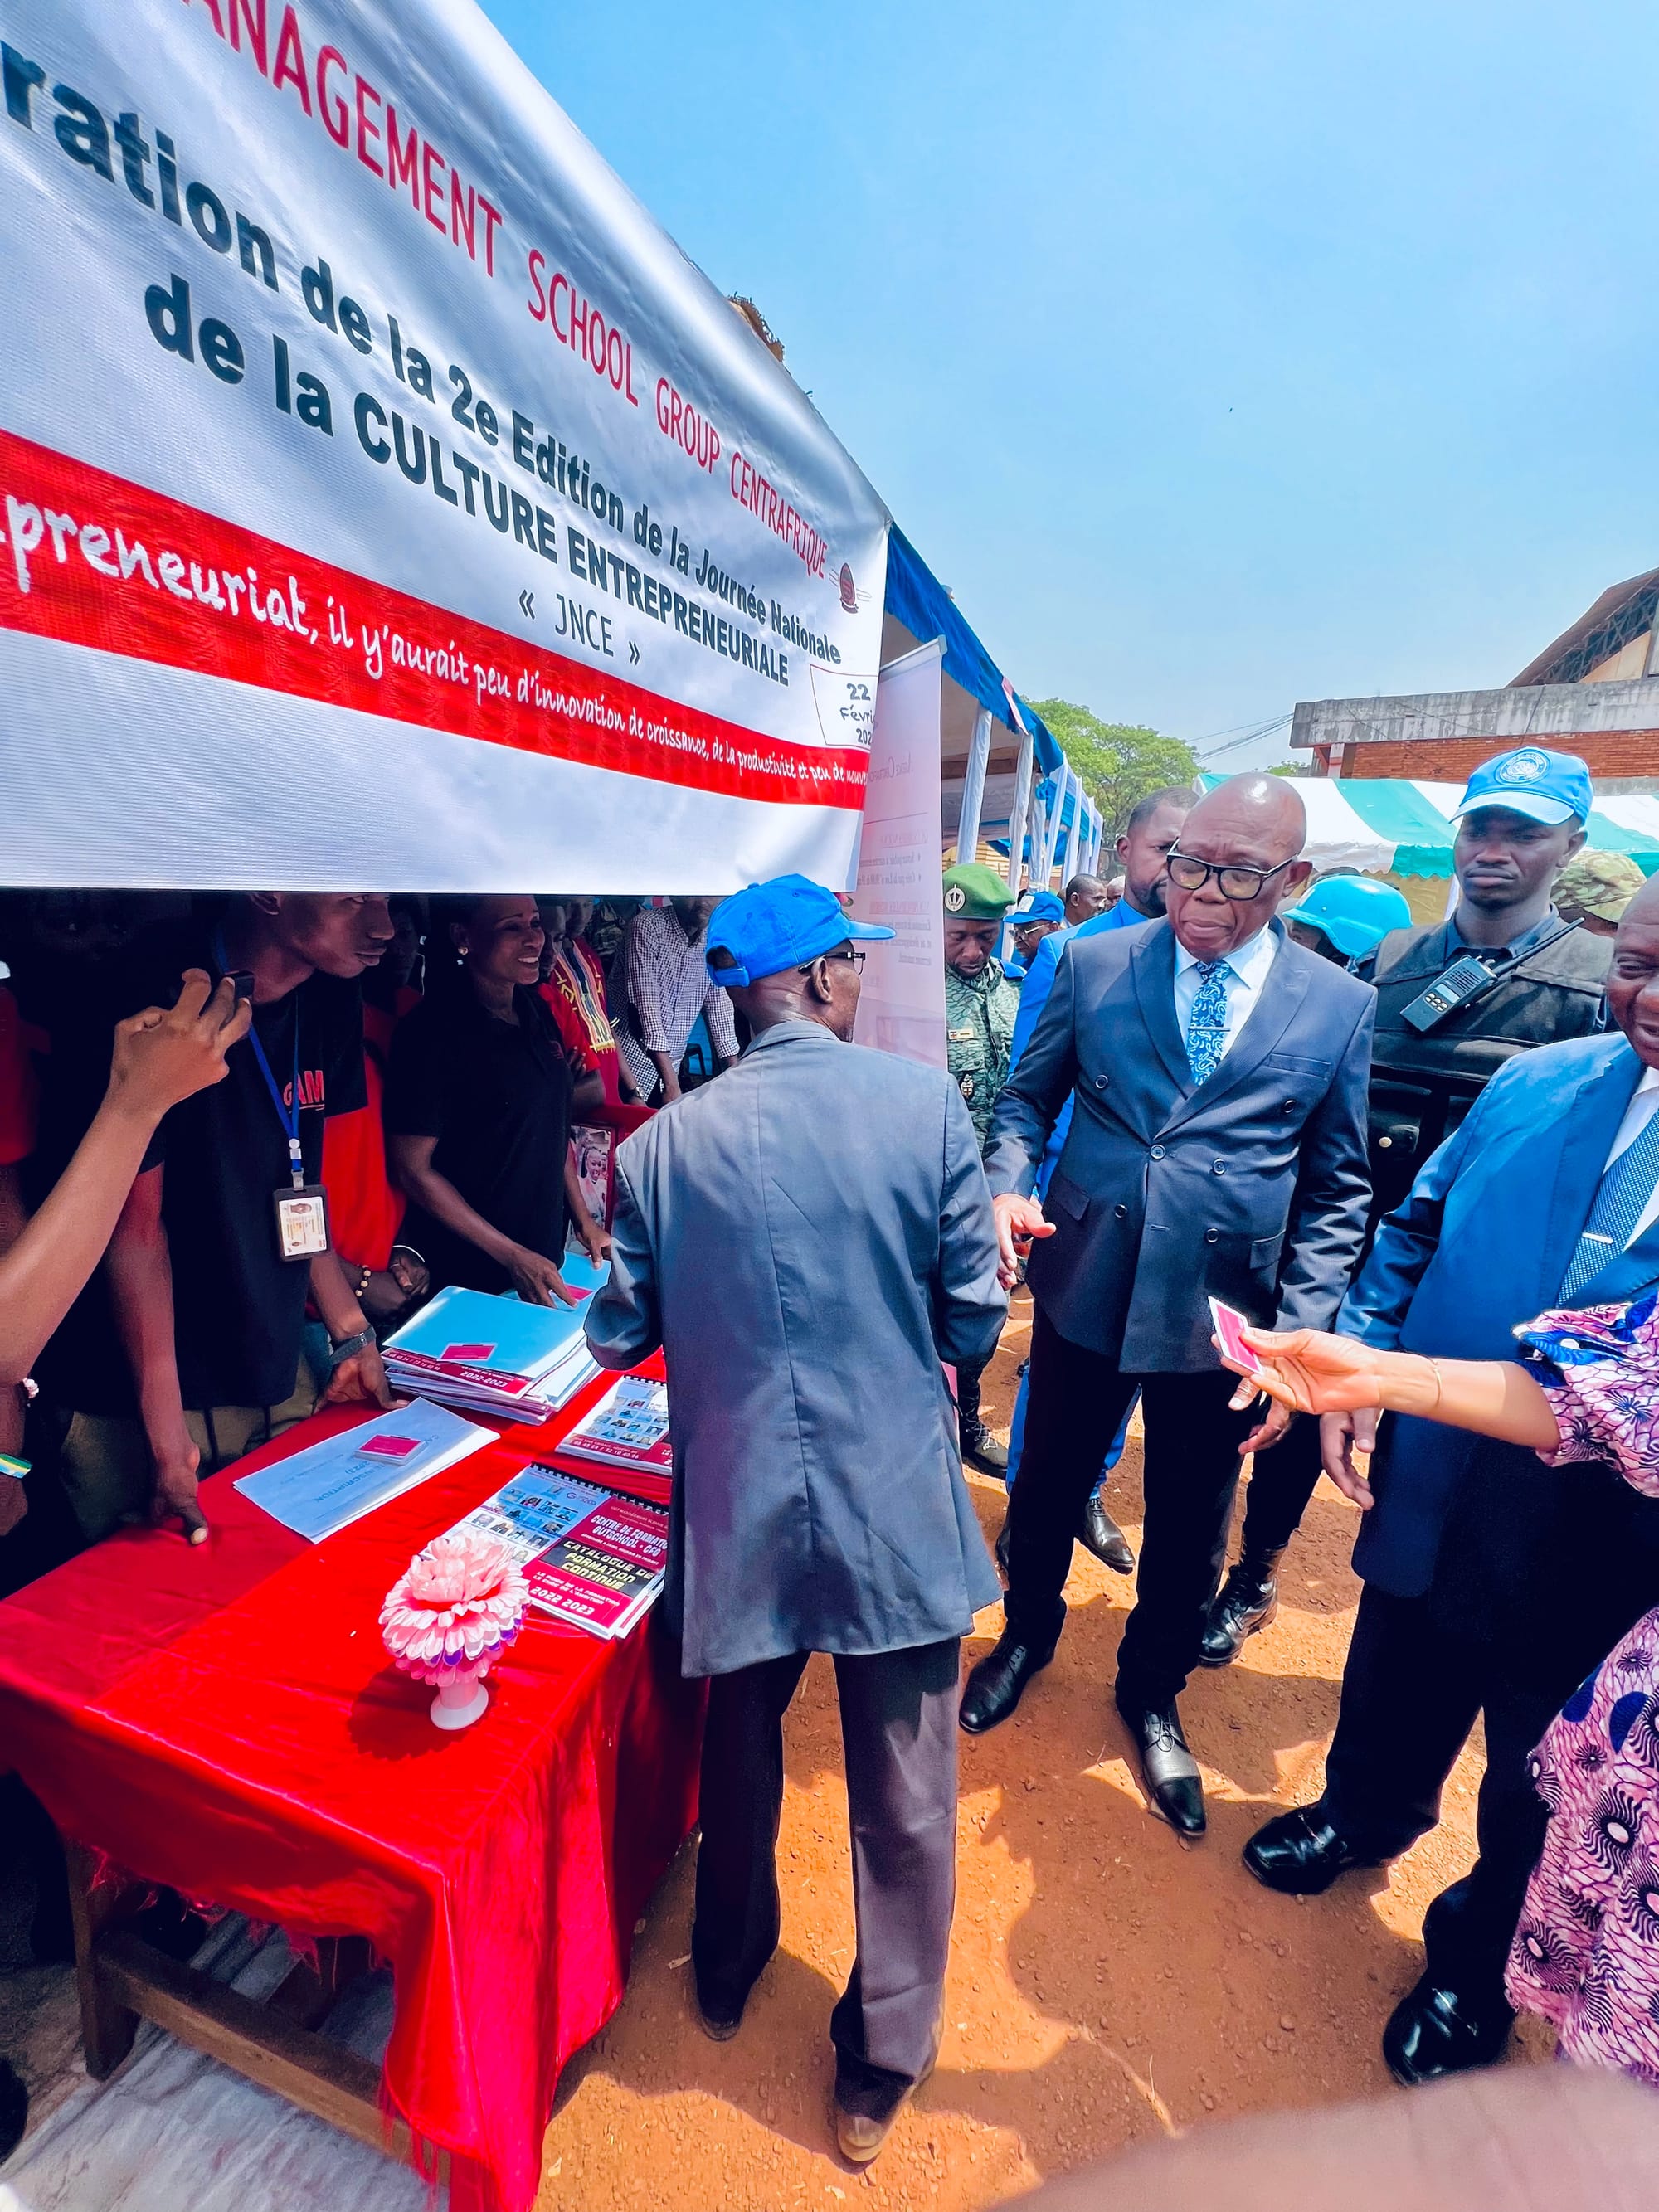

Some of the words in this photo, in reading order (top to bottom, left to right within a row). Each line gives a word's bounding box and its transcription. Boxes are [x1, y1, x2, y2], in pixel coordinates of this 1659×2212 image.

[528, 249, 639, 407] SCHOOL
[655, 377, 720, 474] GROUP
[730, 452, 828, 579] CENTRAFRIQUE
[301, 257, 371, 354] de
[387, 313, 435, 404] la
[449, 364, 499, 445] 2e
[512, 408, 624, 532] Edition
[633, 503, 662, 556] de
[669, 526, 690, 576] la
[694, 548, 766, 625] Journée
[770, 596, 842, 664] Nationale
[144, 273, 245, 384] de
[273, 333, 334, 437] la
[353, 391, 557, 564] CULTURE
[567, 526, 789, 687] ENTREPRENEURIALE
[0, 493, 319, 645] preneuriat,
[328, 596, 353, 648] il
[362, 625, 469, 684] y'aurait
[474, 663, 511, 705] peu
[517, 668, 625, 731] d'innovation
[629, 707, 645, 739] de
[647, 717, 709, 761] croissance,
[713, 736, 723, 763] de
[726, 741, 736, 764] la
[737, 750, 796, 778] productivité
[798, 763, 809, 779] et
[810, 766, 831, 786] peu
[833, 761, 844, 782] de
[554, 594, 614, 657] JNCE
[846, 683, 871, 701] 22
[591, 1515, 622, 1532] CENTRE
[619, 1524, 635, 1535] DE
[564, 1541, 635, 1572] CATALOGUE
[635, 1568, 655, 1580] DE
[565, 1552, 636, 1583] FORMATION
[643, 1544, 662, 1557] CFO
[561, 1562, 625, 1589] CONTINUE
[530, 1586, 563, 1603] 2022
[561, 1598, 595, 1616] 2023
